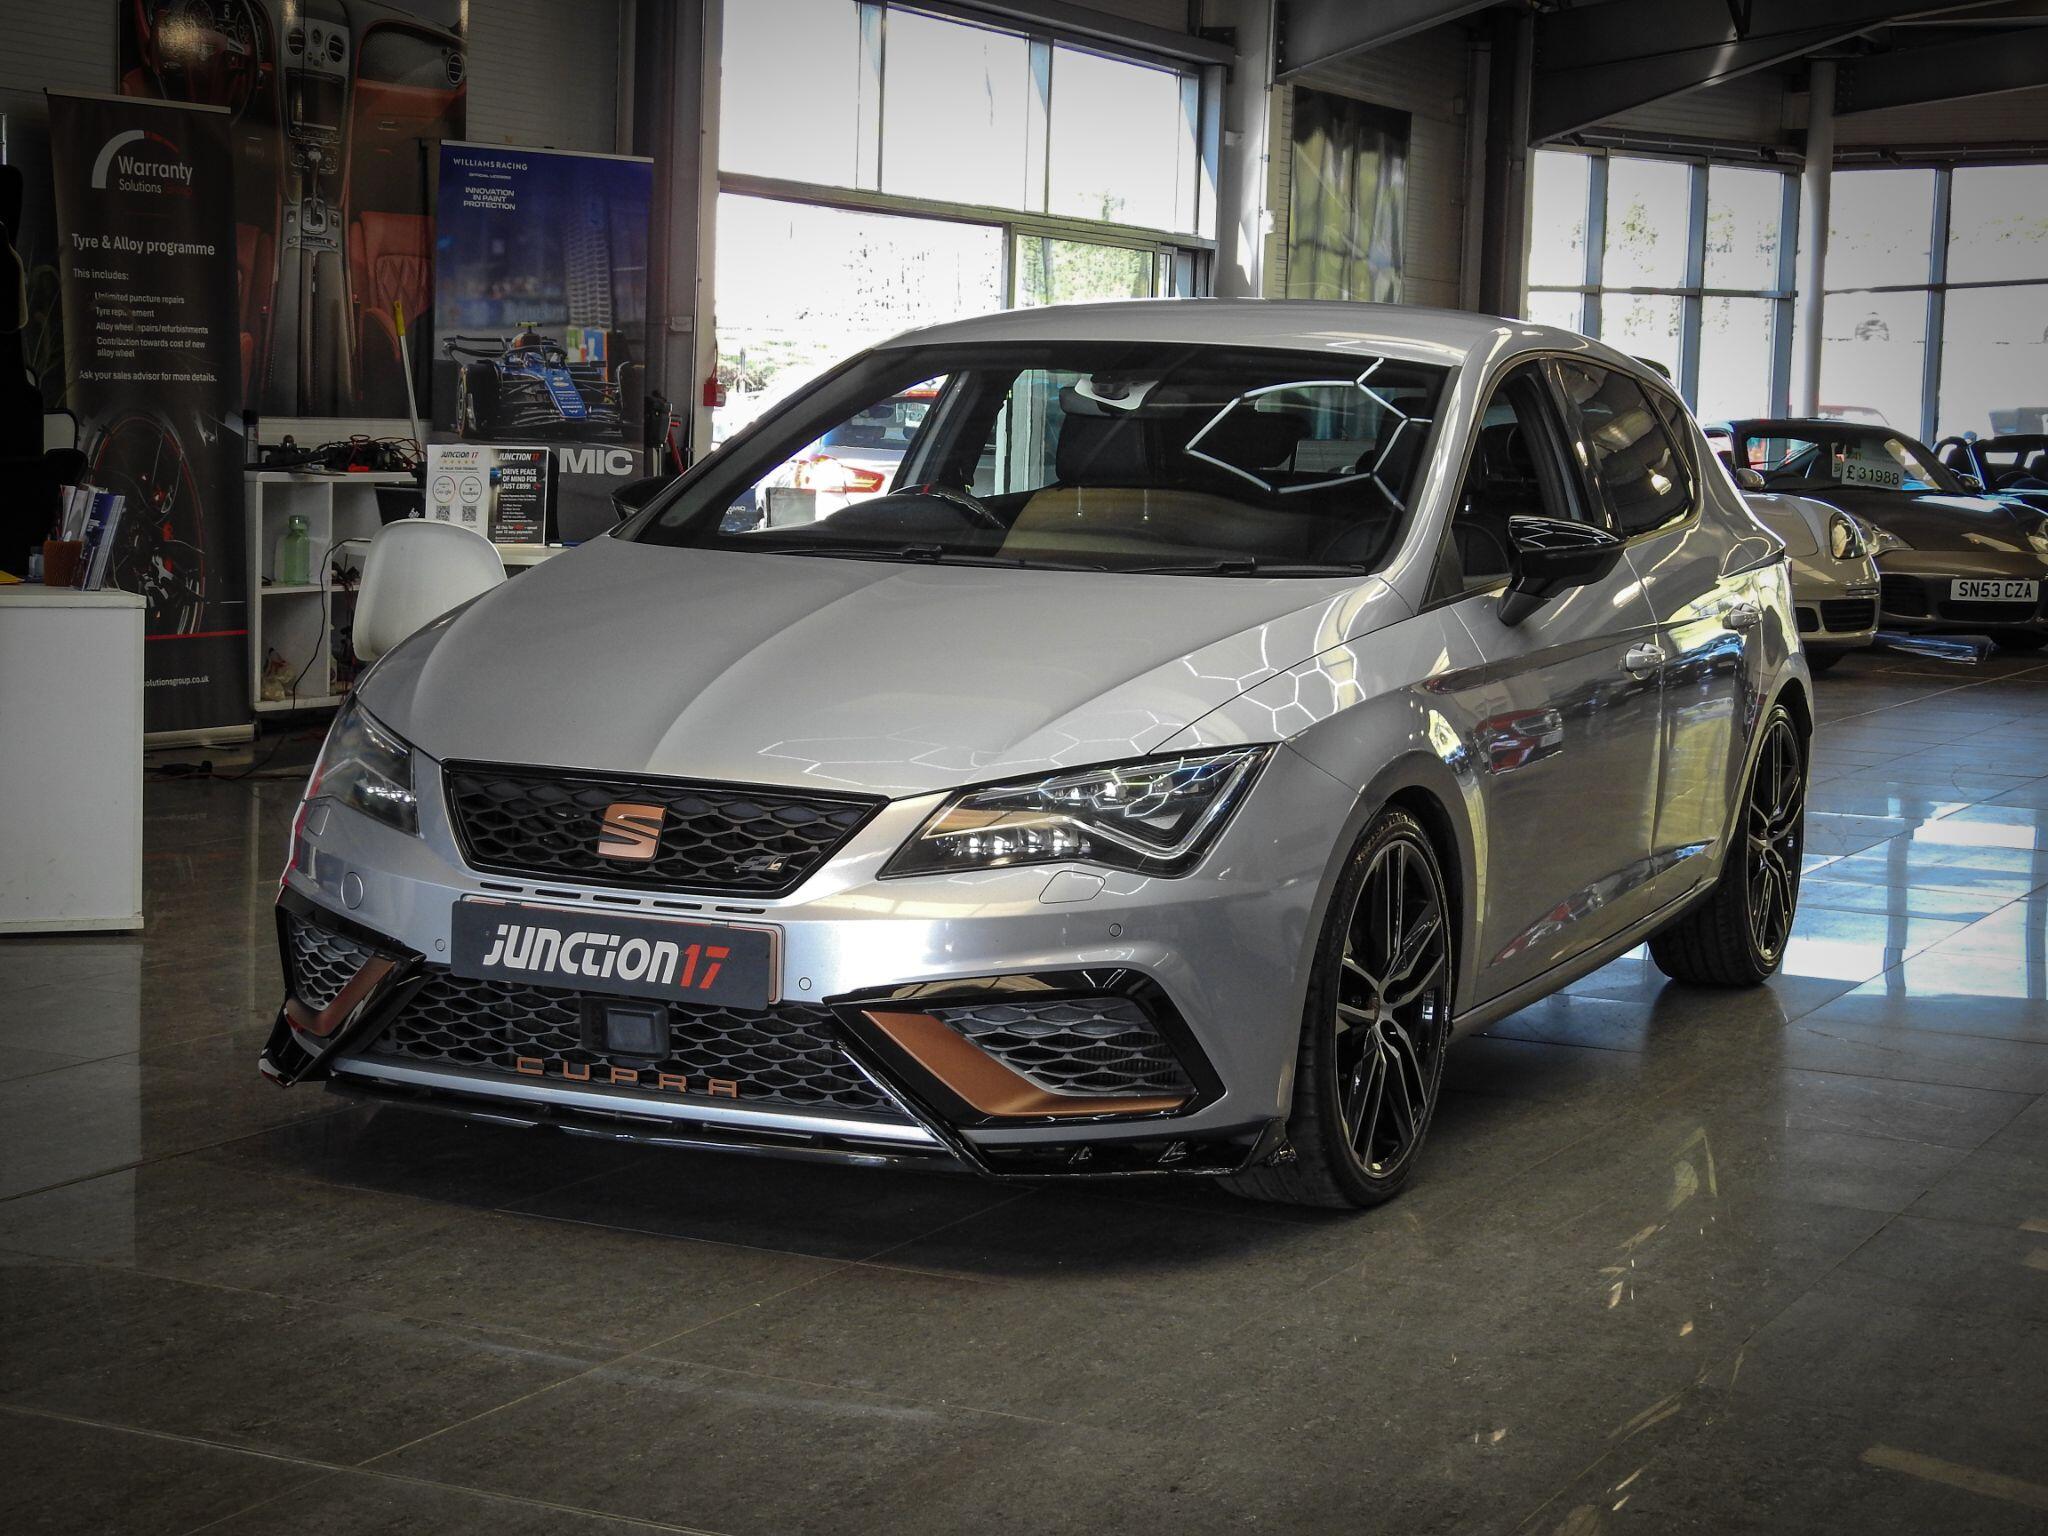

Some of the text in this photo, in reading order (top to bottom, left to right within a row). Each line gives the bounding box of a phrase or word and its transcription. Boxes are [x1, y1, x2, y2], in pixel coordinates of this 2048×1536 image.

[118, 156, 193, 185] Warranty
[119, 179, 162, 194] Solutions
[465, 187, 515, 197] INNOVATION
[482, 195, 507, 203] PAINT
[463, 200, 516, 211] PROTECTION
[72, 233, 215, 256] Tyre & Alloy programme
[73, 268, 129, 281] This includes:
[129, 294, 161, 305] puncture
[162, 295, 185, 305] repairs
[96, 306, 155, 319] Tyre repement
[96, 322, 114, 333] Alloy
[114, 323, 134, 332] wheel
[97, 336, 206, 349] Contribution towards cost of new
[97, 348, 135, 359] alloy wheel
[79, 370, 218, 382] Ask your sales advisor for more details.
[520, 468, 537, 476] PEACE
[1846, 464, 1899, 486] £31988
[511, 475, 526, 483] MIND
[526, 475, 537, 483] FOR
[1958, 581, 2032, 599] SN53 CZA
[144, 675, 210, 687] olutionsgroup.co.uk
[516, 1056, 739, 1099] CUPRA
